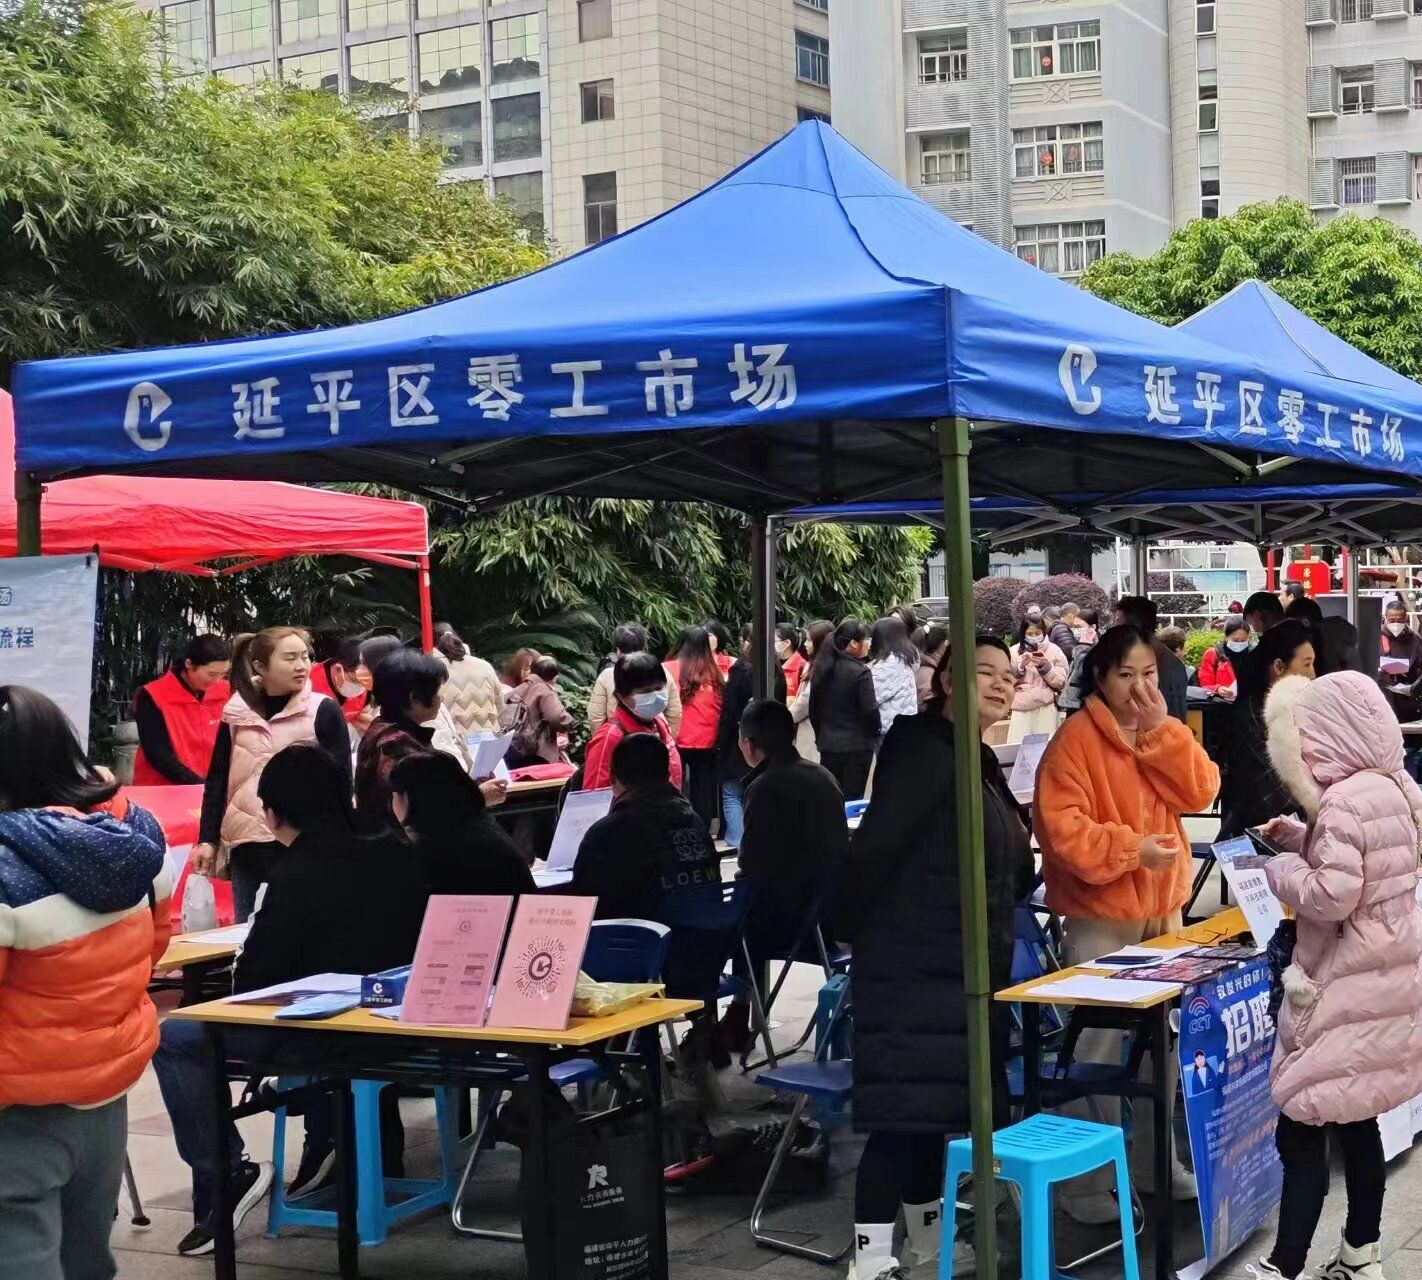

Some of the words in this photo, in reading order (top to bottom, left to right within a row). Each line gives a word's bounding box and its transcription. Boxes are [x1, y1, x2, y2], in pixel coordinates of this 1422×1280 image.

[231, 343, 798, 441] 延平区零工市场
[1143, 364, 1406, 463] 延平区零工市场
[1221, 990, 1276, 1058] 招聘
[858, 1234, 870, 1250] P
[924, 1210, 938, 1226] P
